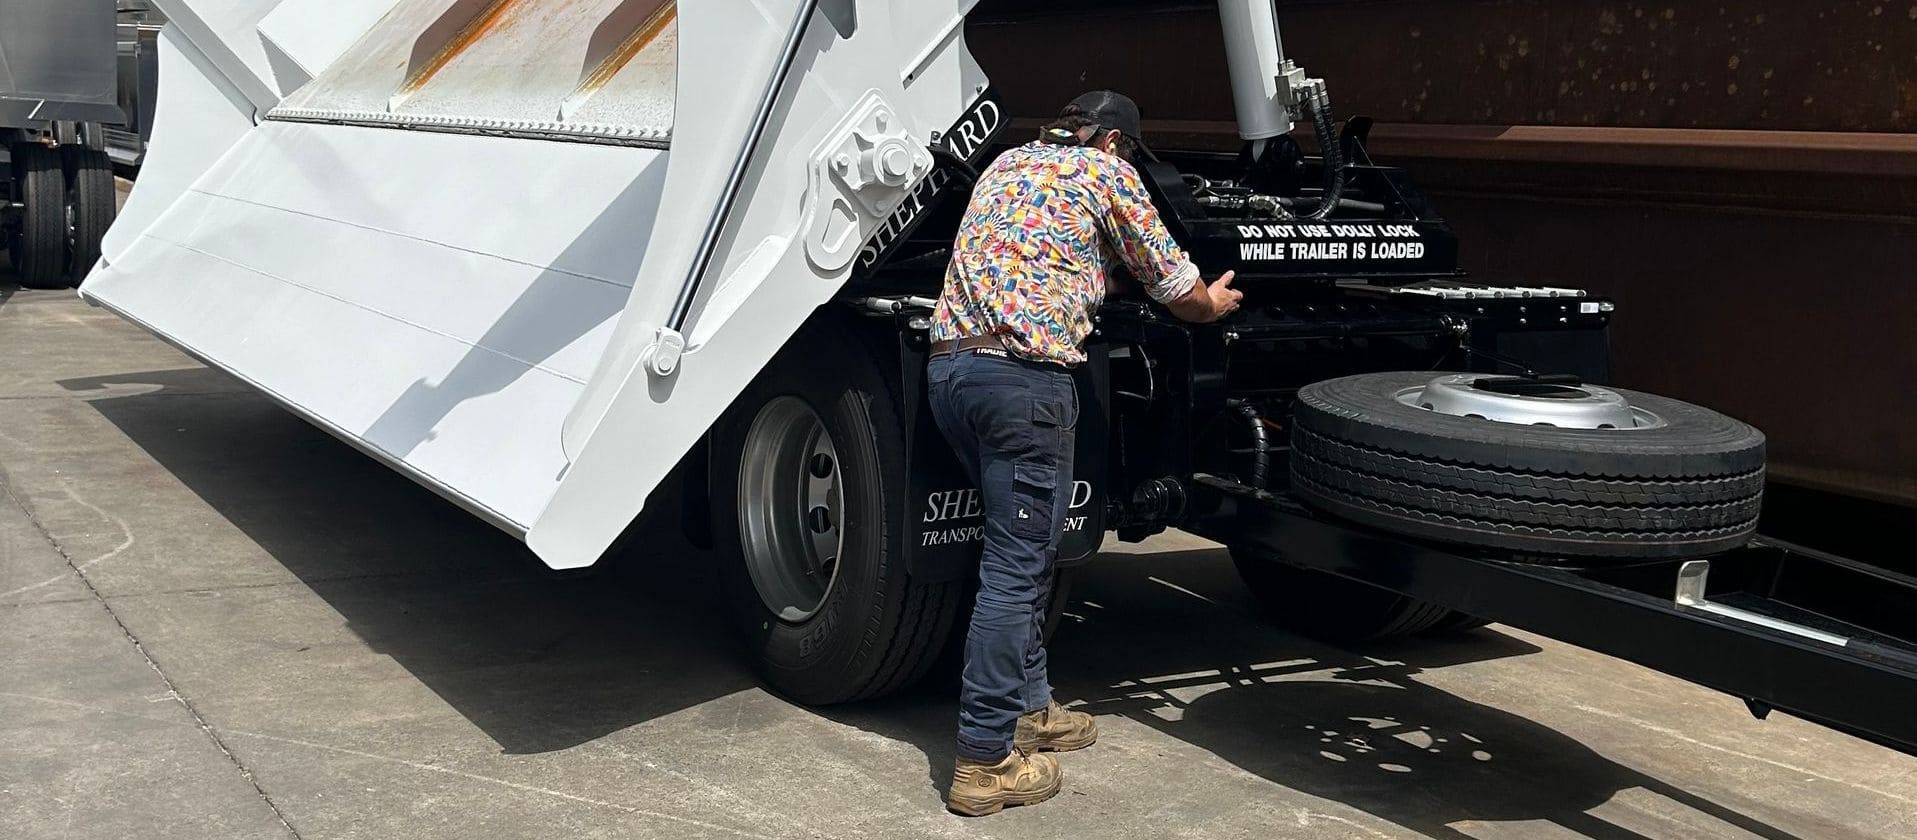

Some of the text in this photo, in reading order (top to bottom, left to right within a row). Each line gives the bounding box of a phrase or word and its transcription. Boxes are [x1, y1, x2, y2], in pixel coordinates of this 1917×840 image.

[1237, 225, 1420, 238] DO NOT USE DOLLY LOCK
[1240, 242, 1425, 260] WHILE TRAILER IS LOADED
[921, 525, 985, 547] TRANSPO
